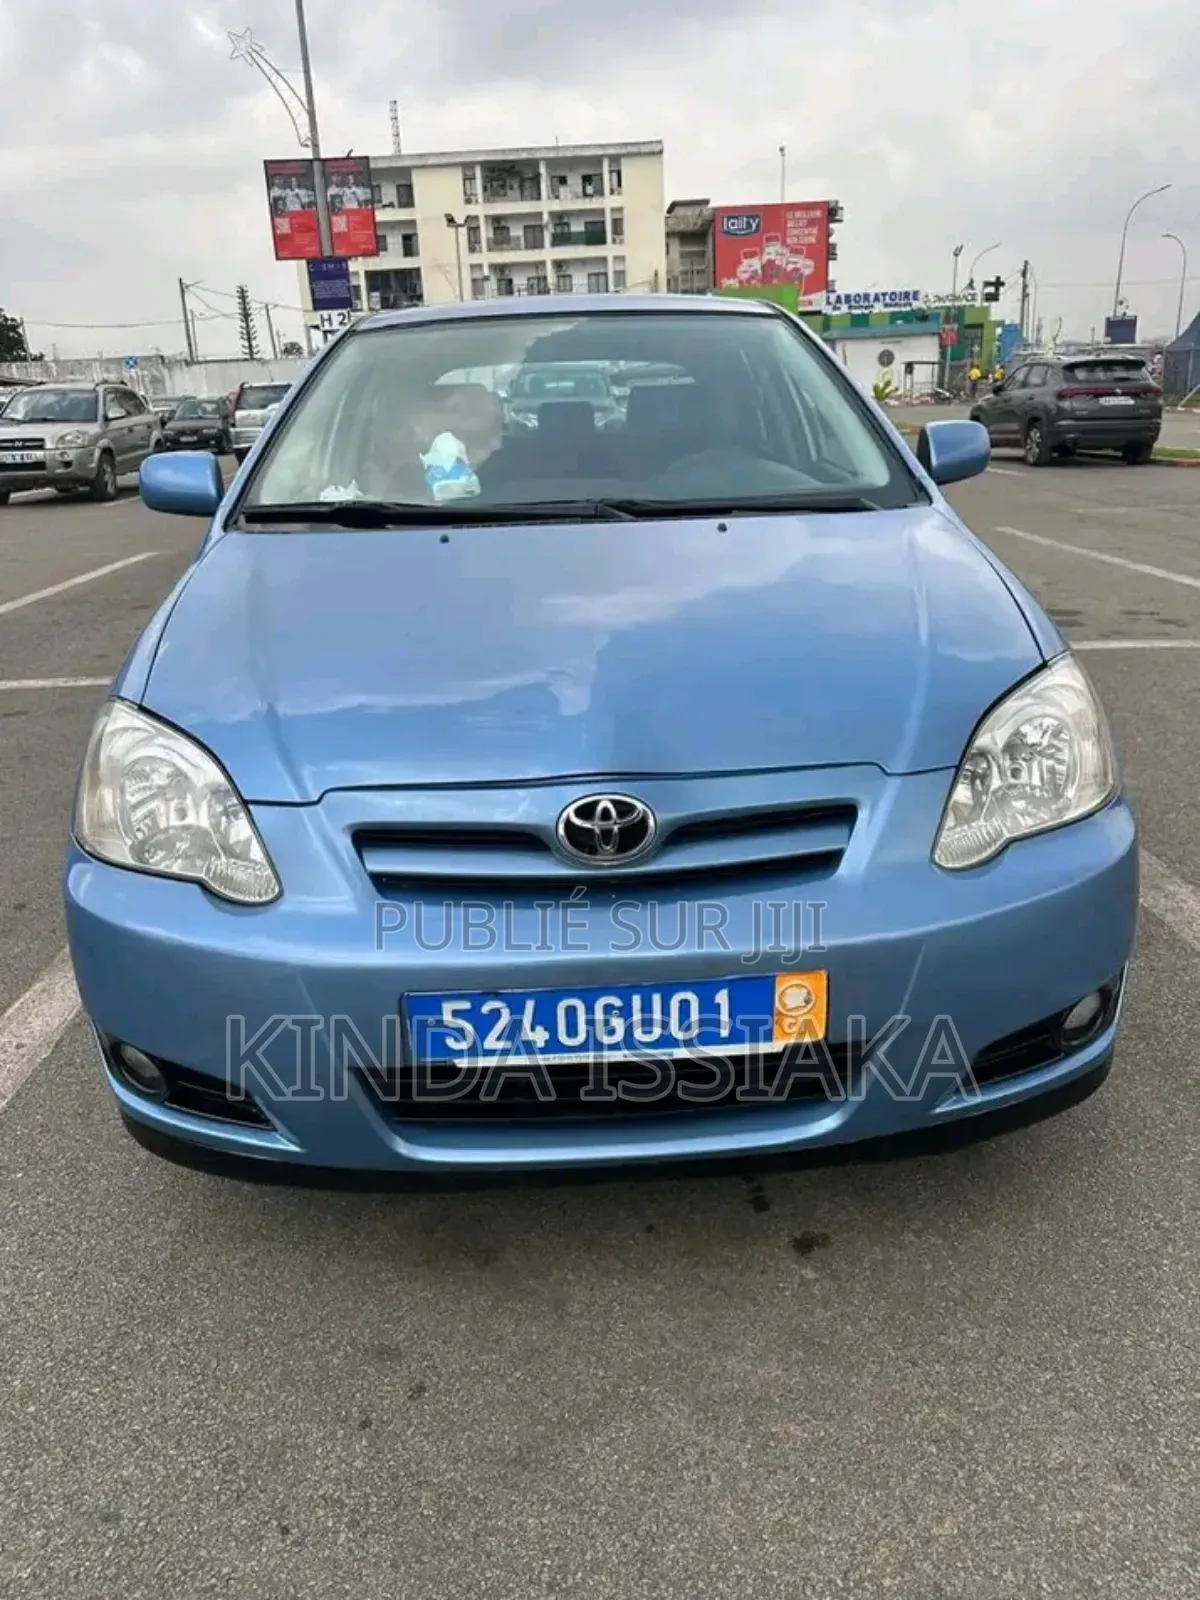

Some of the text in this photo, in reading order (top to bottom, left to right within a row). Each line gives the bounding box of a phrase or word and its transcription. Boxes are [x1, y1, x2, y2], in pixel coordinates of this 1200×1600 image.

[722, 215, 760, 234] laity
[825, 289, 920, 306] LABORATOIRE
[319, 313, 333, 328] H
